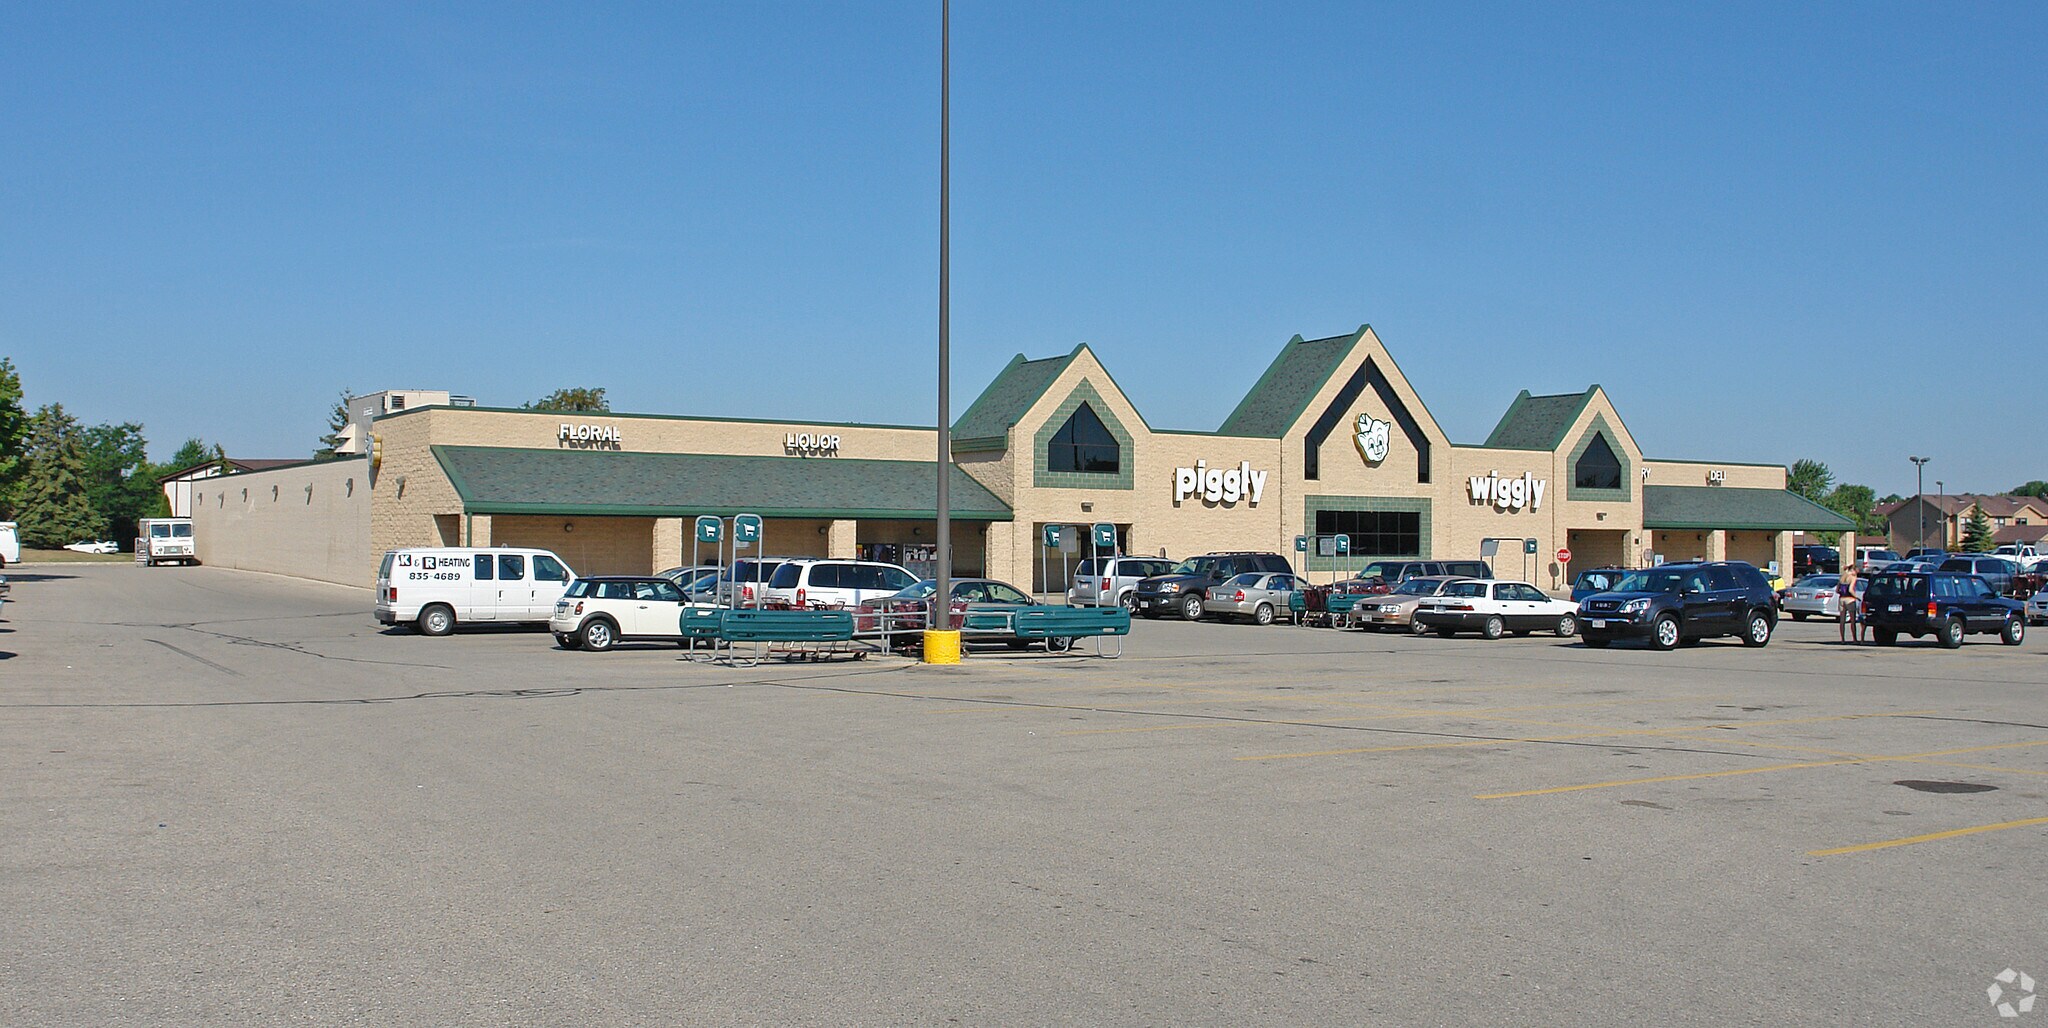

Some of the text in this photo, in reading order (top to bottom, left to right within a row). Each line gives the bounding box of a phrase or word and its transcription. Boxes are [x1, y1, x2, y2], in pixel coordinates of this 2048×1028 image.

[560, 424, 622, 441] FLORAL
[787, 433, 840, 450] LIQUOR
[1641, 467, 1651, 478] RY
[1710, 470, 1727, 480] DELI
[1175, 460, 1546, 508] piggly wiggly
[400, 554, 411, 566] K
[424, 557, 435, 569] R
[438, 558, 471, 567] HEATING
[408, 572, 461, 581] 835-4689
